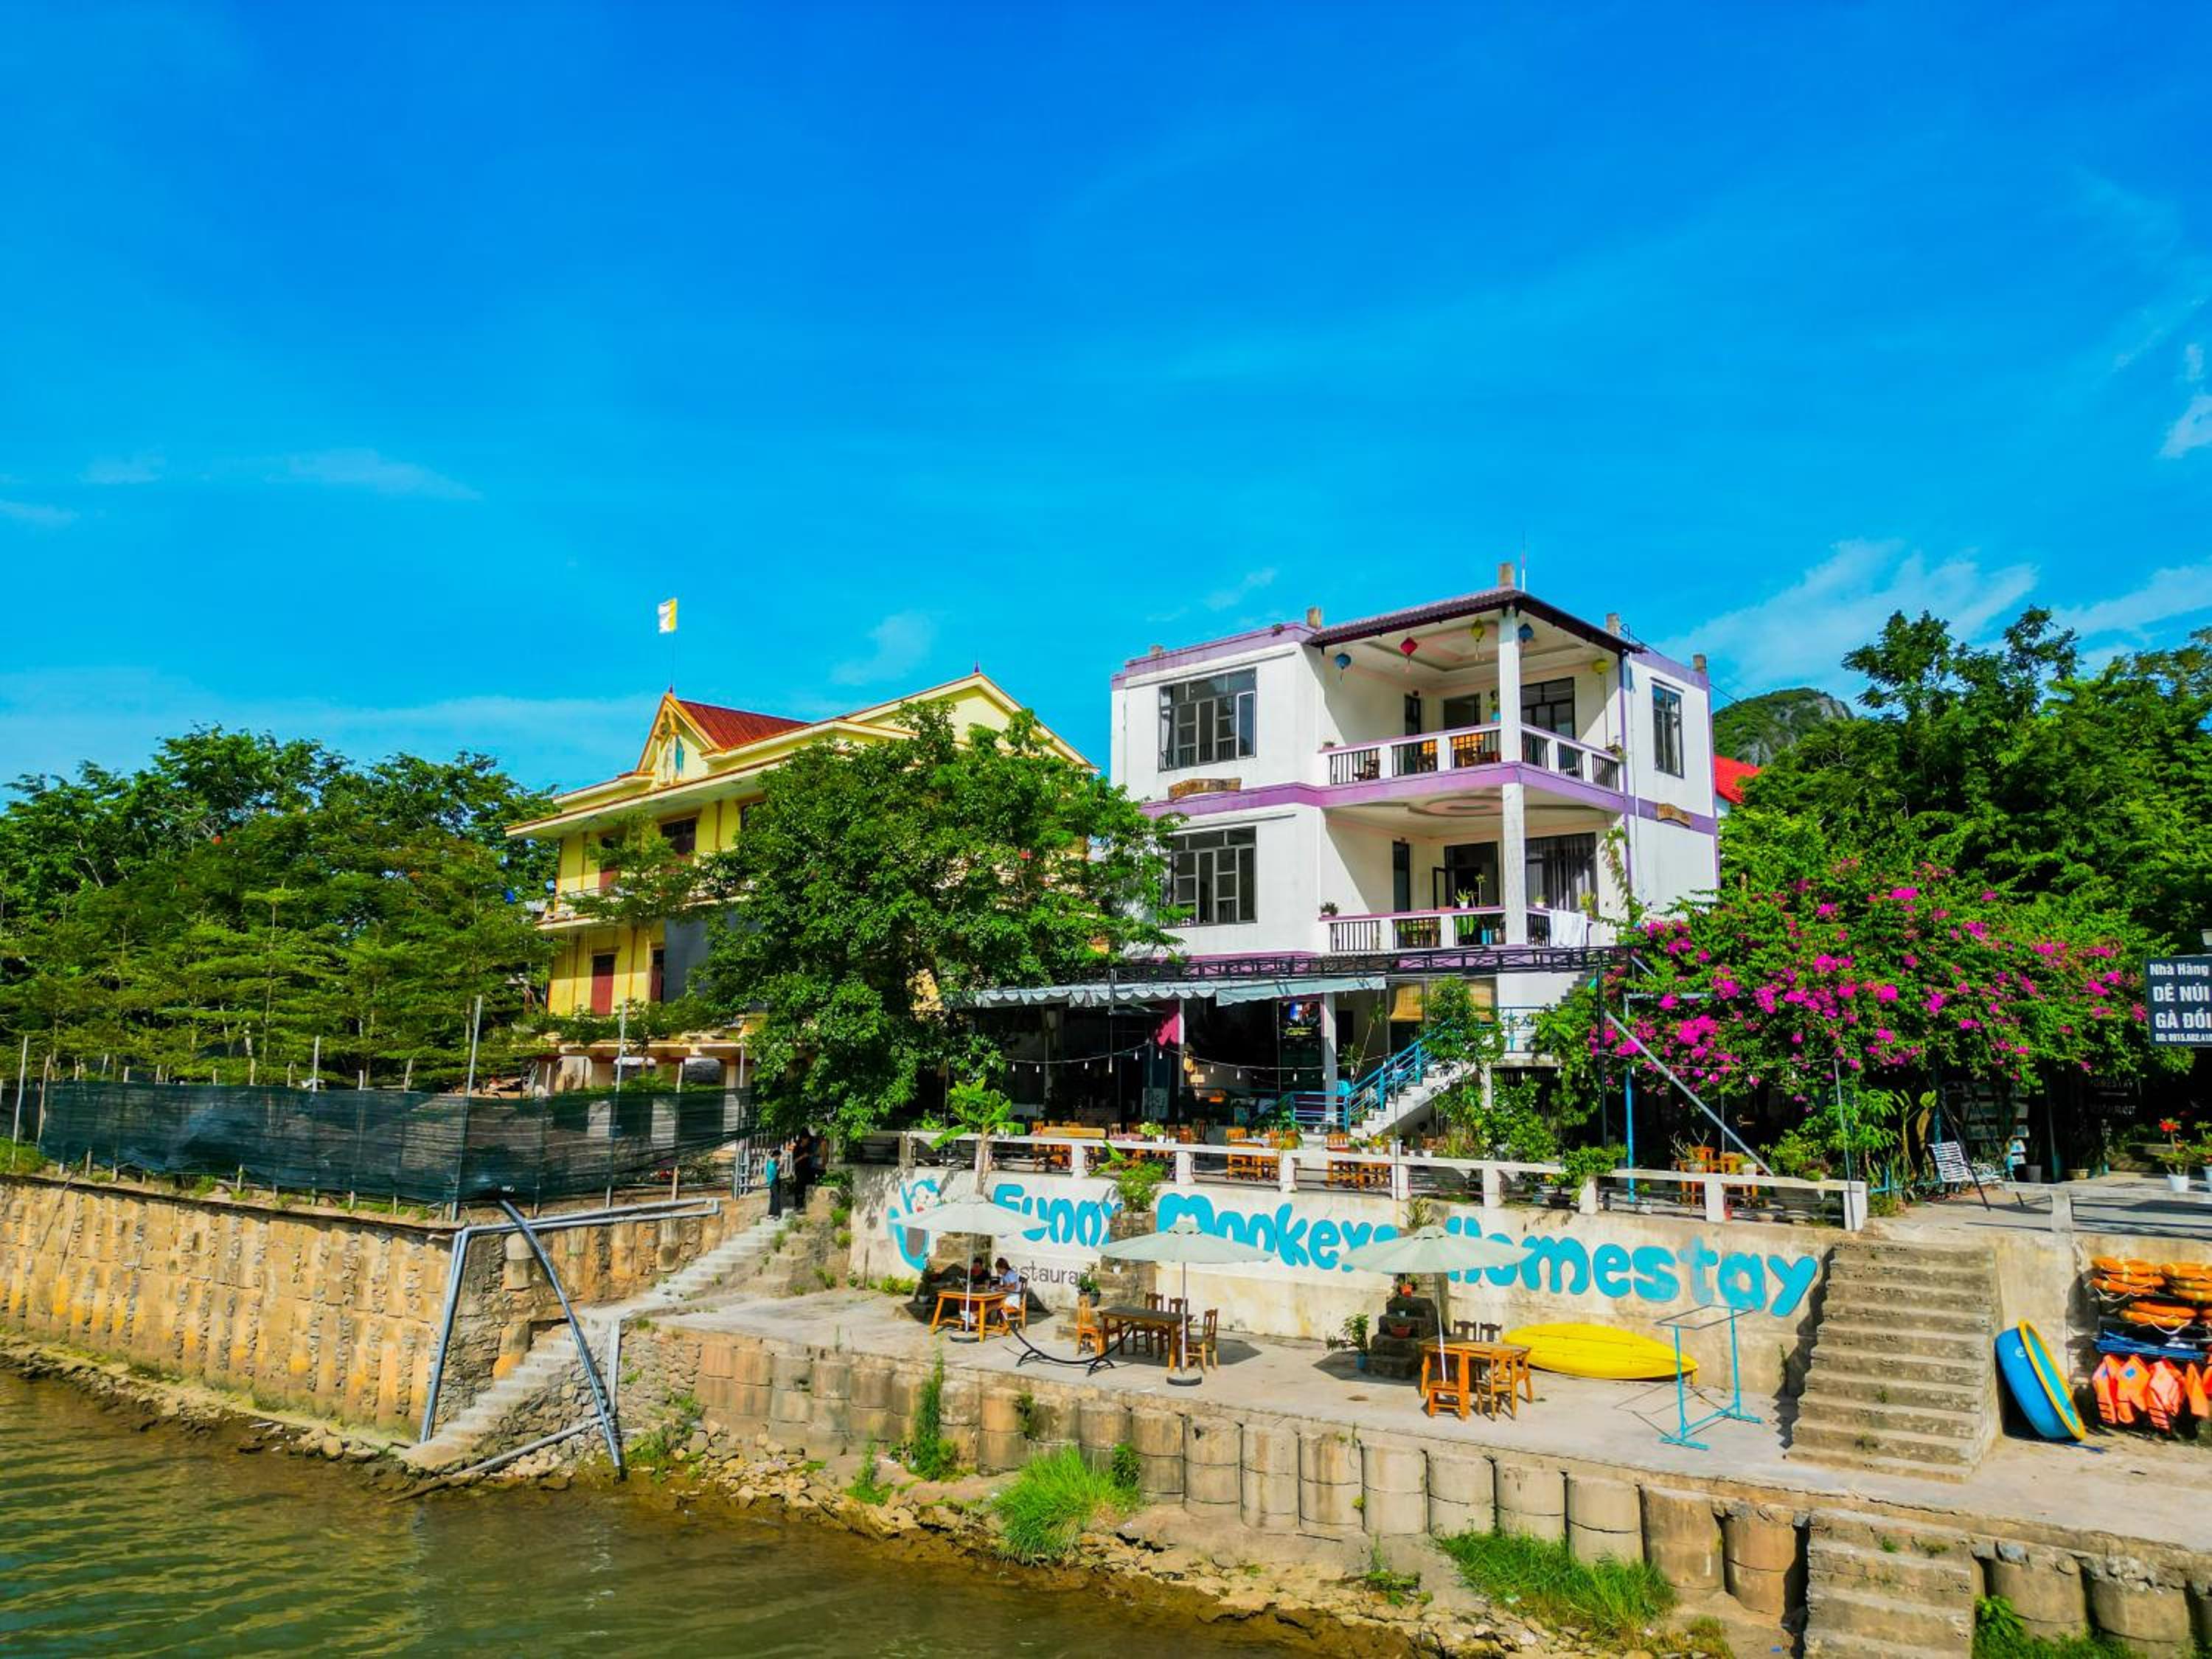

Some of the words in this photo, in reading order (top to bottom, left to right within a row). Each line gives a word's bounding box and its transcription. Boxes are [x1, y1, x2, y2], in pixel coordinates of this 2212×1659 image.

[2177, 962, 2209, 976] Hàng
[2153, 983, 2175, 1002] DÊ
[2179, 982, 2210, 1002] NÚI
[2155, 1009, 2179, 1029] GÀ
[1015, 1260, 1086, 1284] staura
